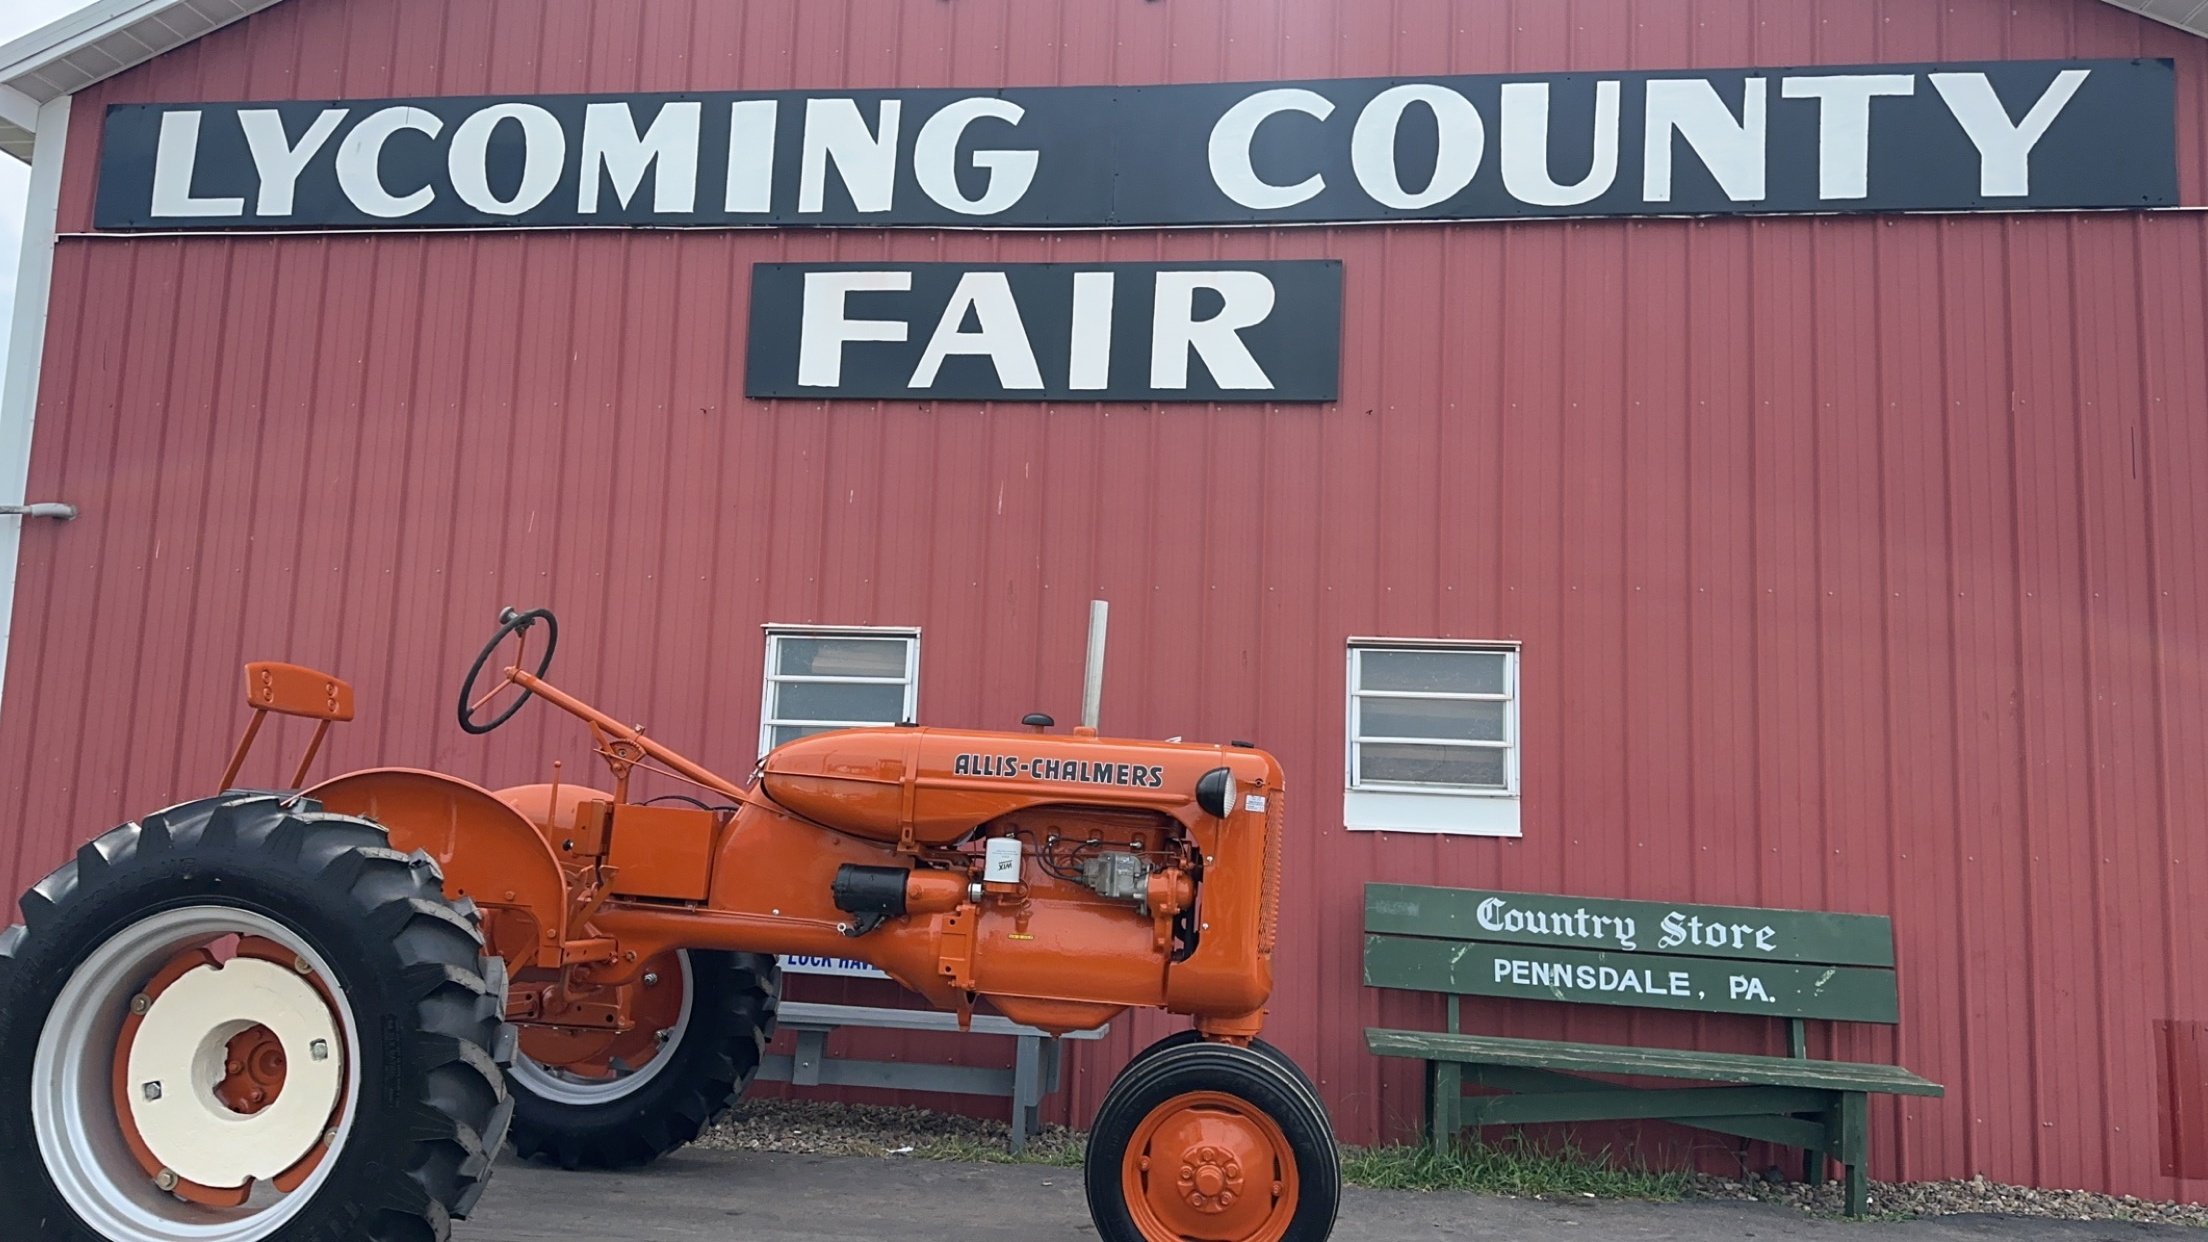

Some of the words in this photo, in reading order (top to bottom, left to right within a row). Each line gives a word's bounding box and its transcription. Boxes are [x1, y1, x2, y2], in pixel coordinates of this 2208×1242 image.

[151, 97, 1039, 218] LYCOMING
[1208, 69, 2091, 210] COUNTY
[797, 271, 1276, 390] FAIR
[954, 754, 1163, 787] ALLIS-CHALMERS
[1477, 896, 1637, 951] Country
[1658, 911, 1777, 951] Store
[1729, 975, 1776, 1003] PA.
